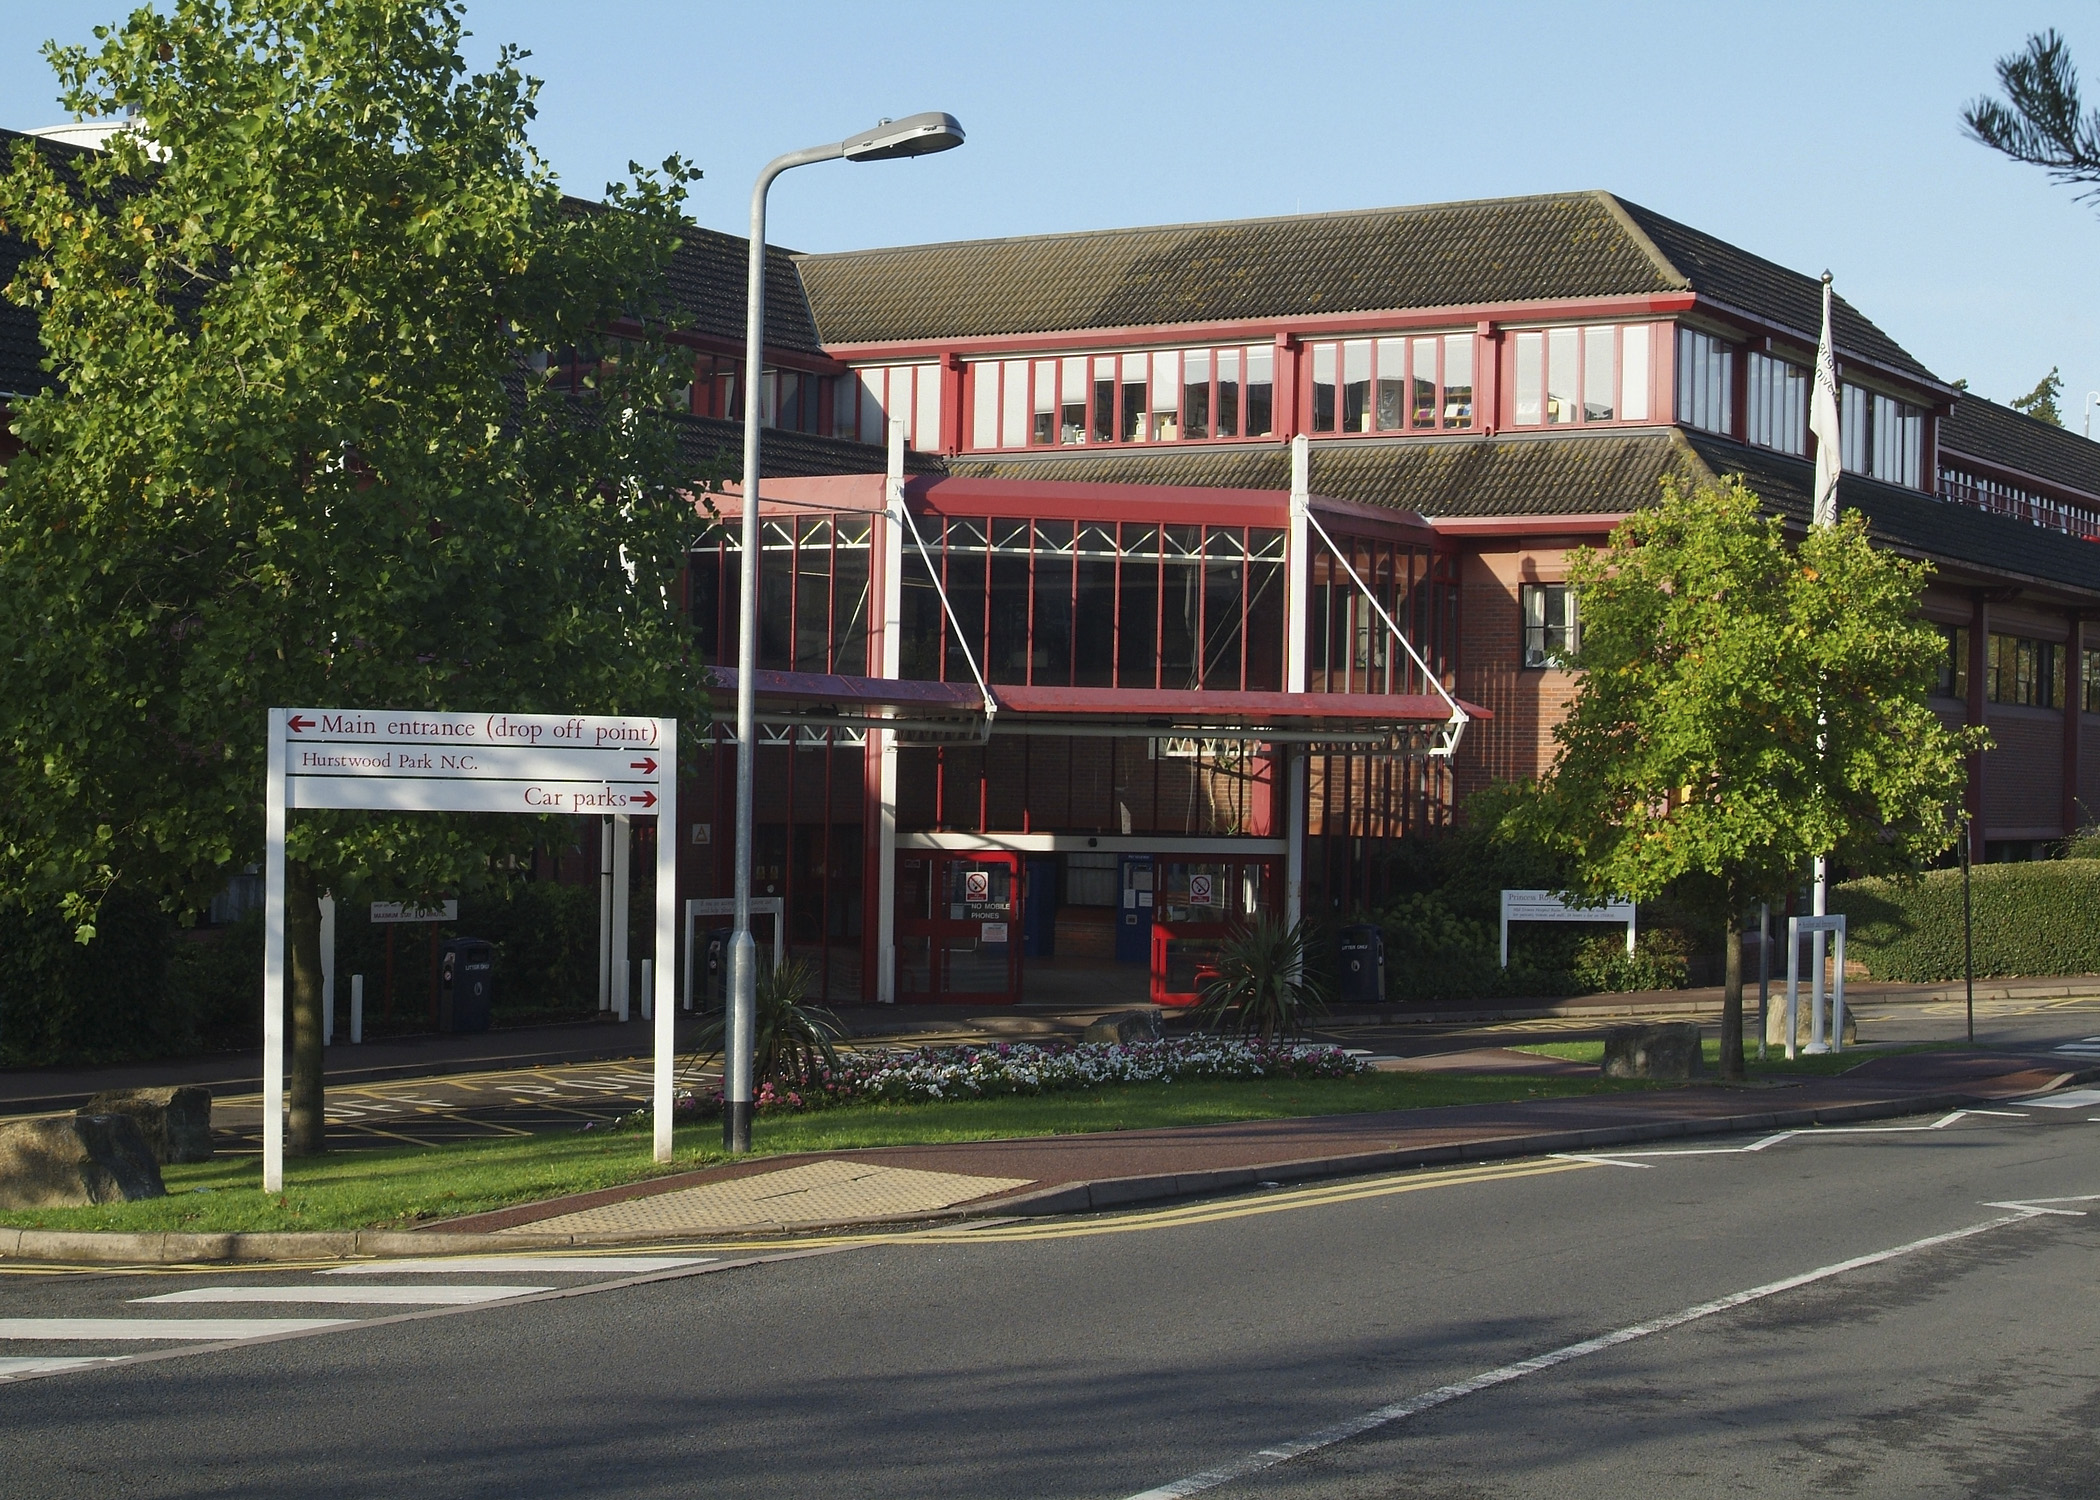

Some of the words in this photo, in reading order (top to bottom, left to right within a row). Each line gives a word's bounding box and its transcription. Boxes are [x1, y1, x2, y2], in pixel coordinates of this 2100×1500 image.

[321, 715, 376, 735] Main
[388, 719, 475, 737] entrance
[486, 714, 543, 742] (drop
[553, 717, 584, 739] off
[595, 718, 659, 746] point)
[302, 752, 391, 768] Hurstwood
[399, 753, 432, 769] Park
[440, 755, 479, 770] N.C.
[524, 787, 563, 806] Car
[573, 788, 628, 812] parks
[1508, 893, 1536, 901] Princess
